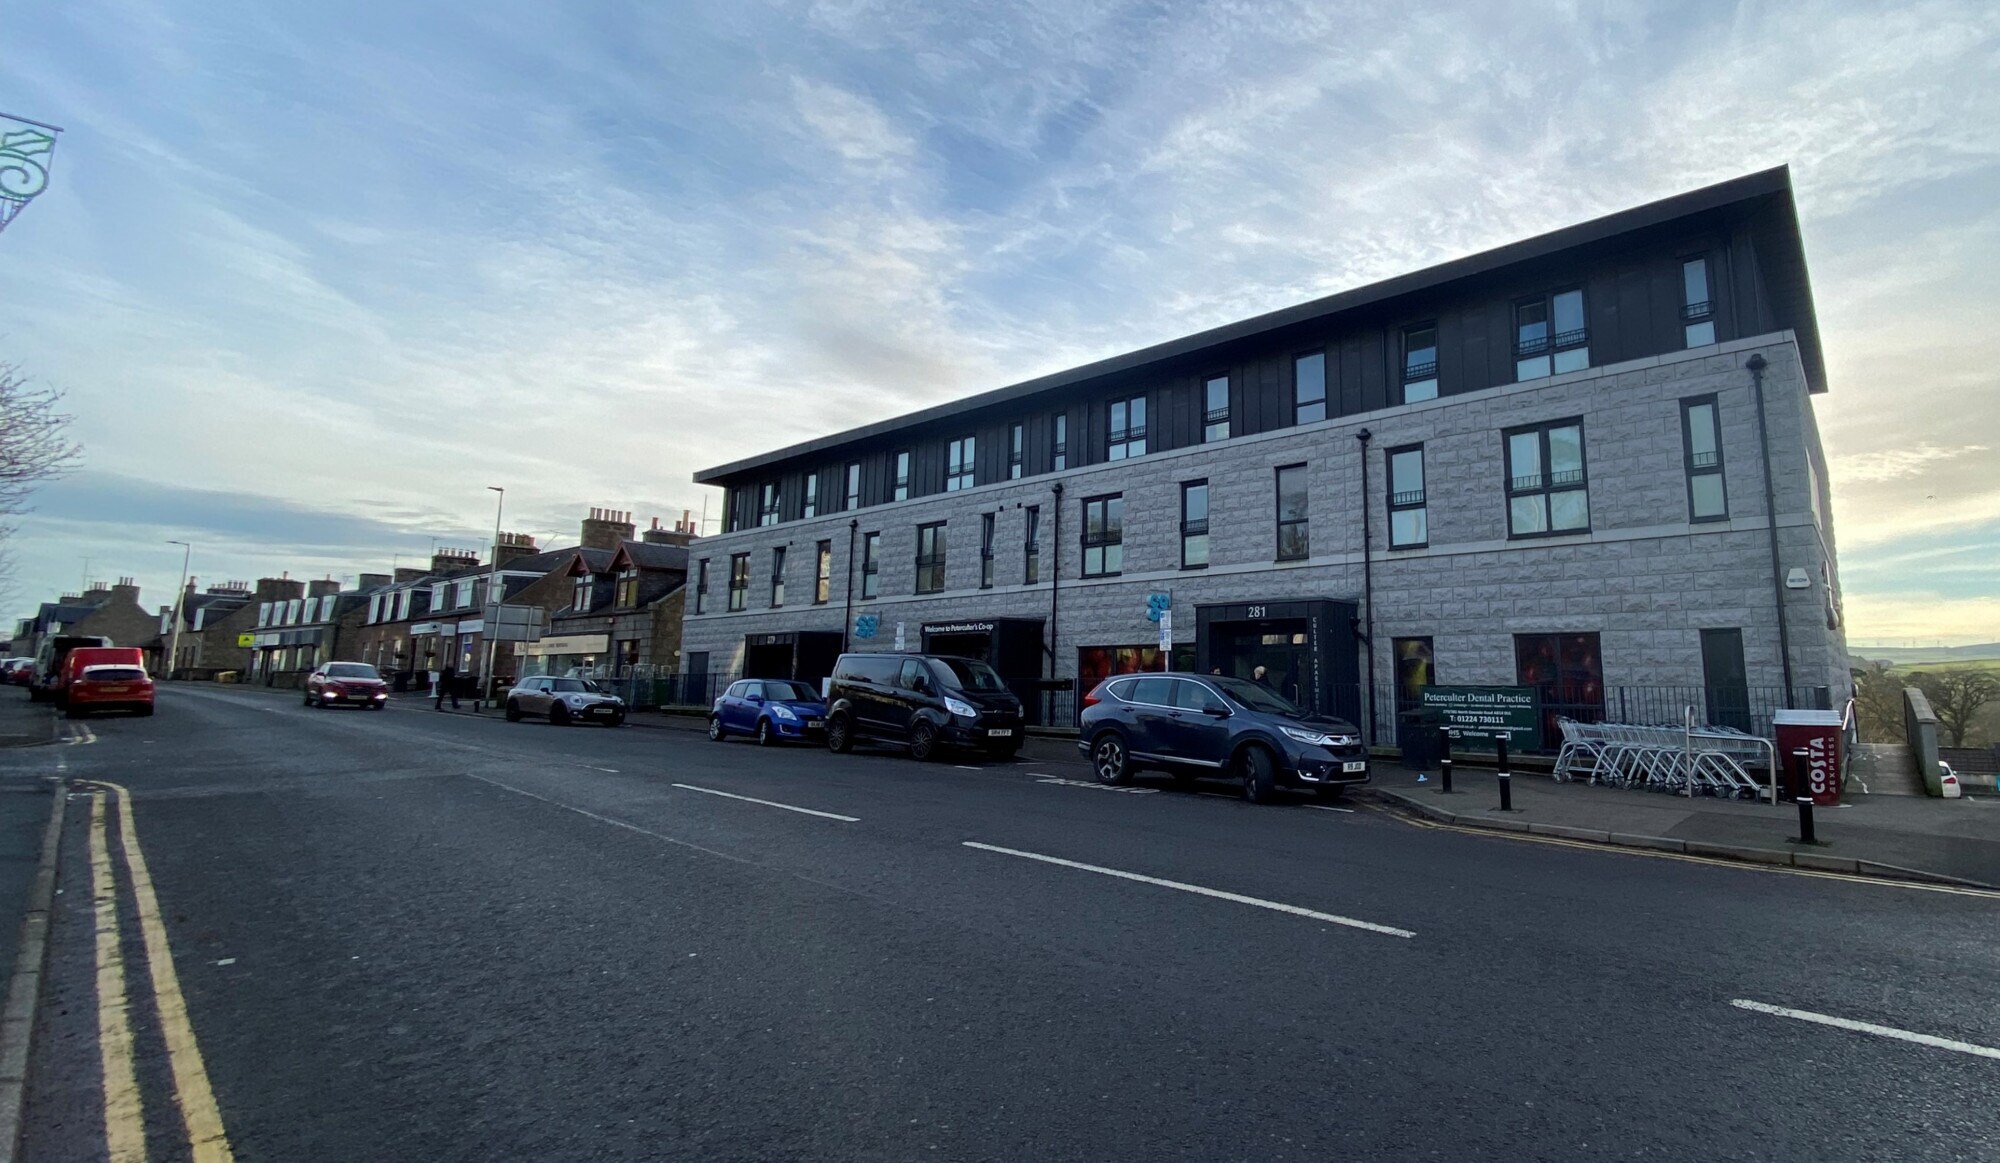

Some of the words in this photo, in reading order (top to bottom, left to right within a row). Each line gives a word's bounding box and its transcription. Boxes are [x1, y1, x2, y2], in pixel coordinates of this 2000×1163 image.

[1248, 606, 1266, 618] 281
[924, 625, 945, 633] Welcome
[951, 623, 978, 632] Peterculter's
[978, 622, 994, 631] Co-op
[1424, 692, 1466, 702] Peterculter
[1467, 693, 1495, 702] Dental
[1497, 693, 1531, 703] Practice
[1457, 715, 1478, 723] 01224
[1479, 716, 1504, 724] 730111
[1809, 737, 1827, 794] COSTA
